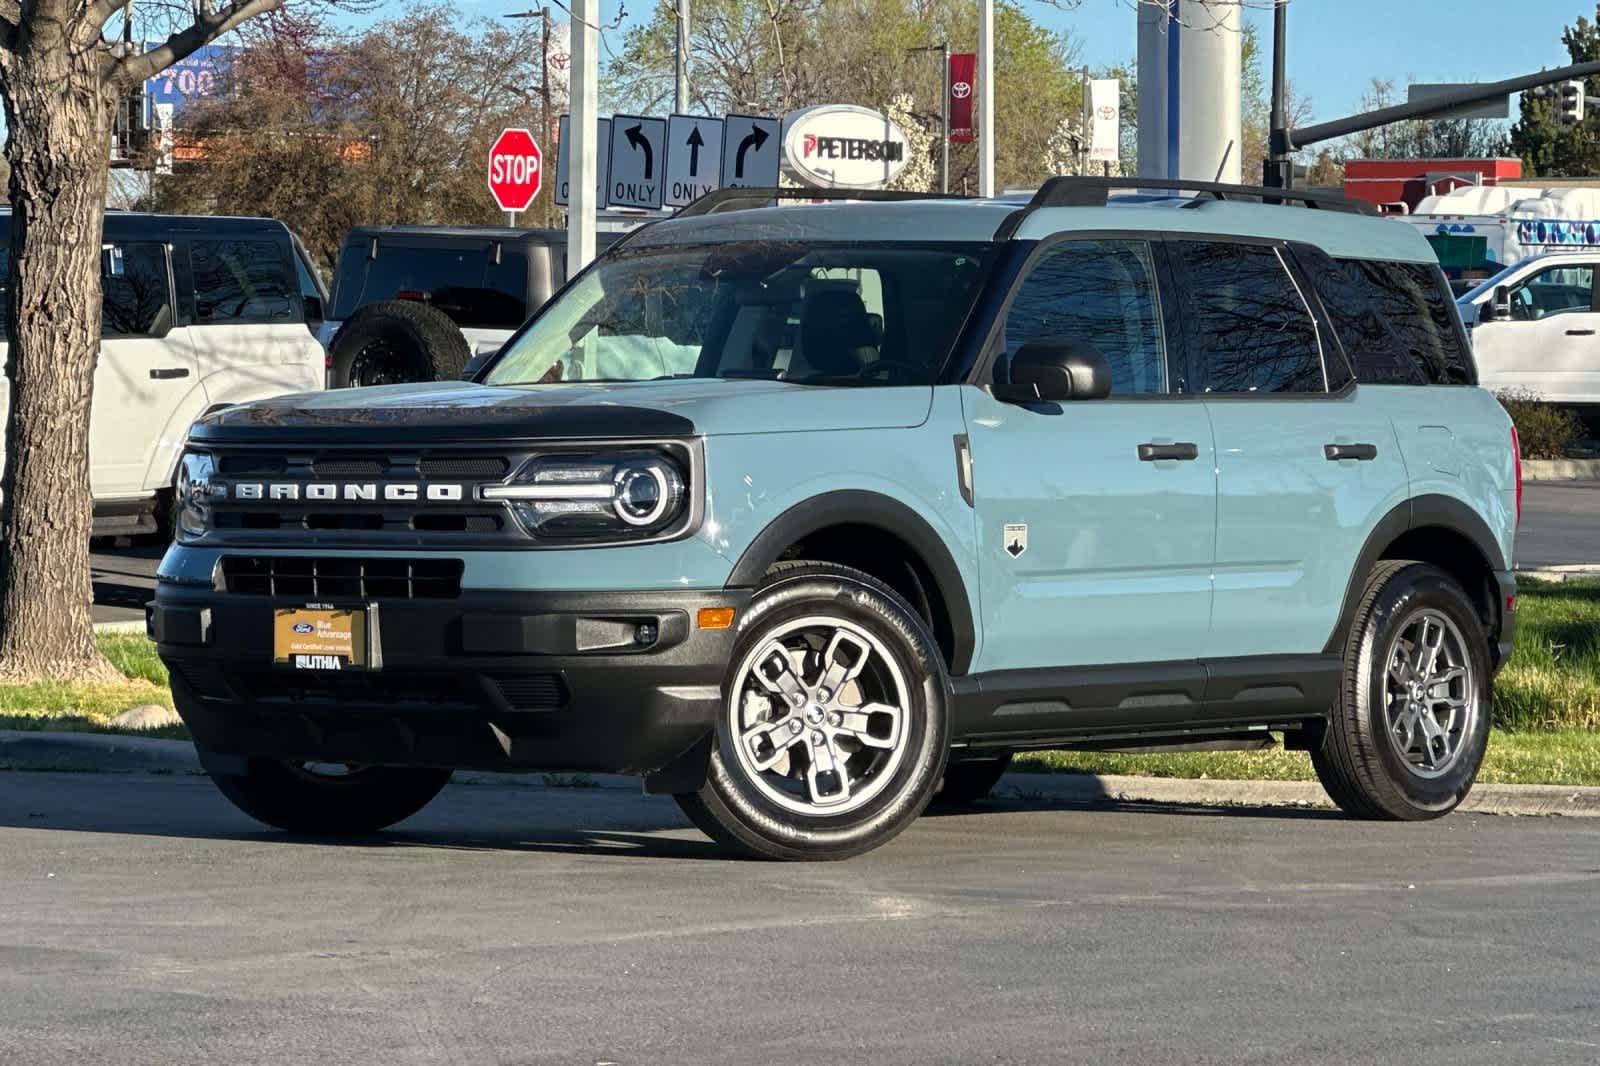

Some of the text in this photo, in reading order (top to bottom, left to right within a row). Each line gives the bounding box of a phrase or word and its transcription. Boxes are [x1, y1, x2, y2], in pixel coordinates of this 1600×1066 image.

[817, 136, 903, 162] PETERSON
[492, 153, 539, 186] STOP
[615, 182, 656, 203] ONLY
[235, 483, 463, 502] BRONCO
[295, 624, 312, 633] Ford
[316, 620, 332, 629] Blue
[307, 655, 341, 670] LITHIA
